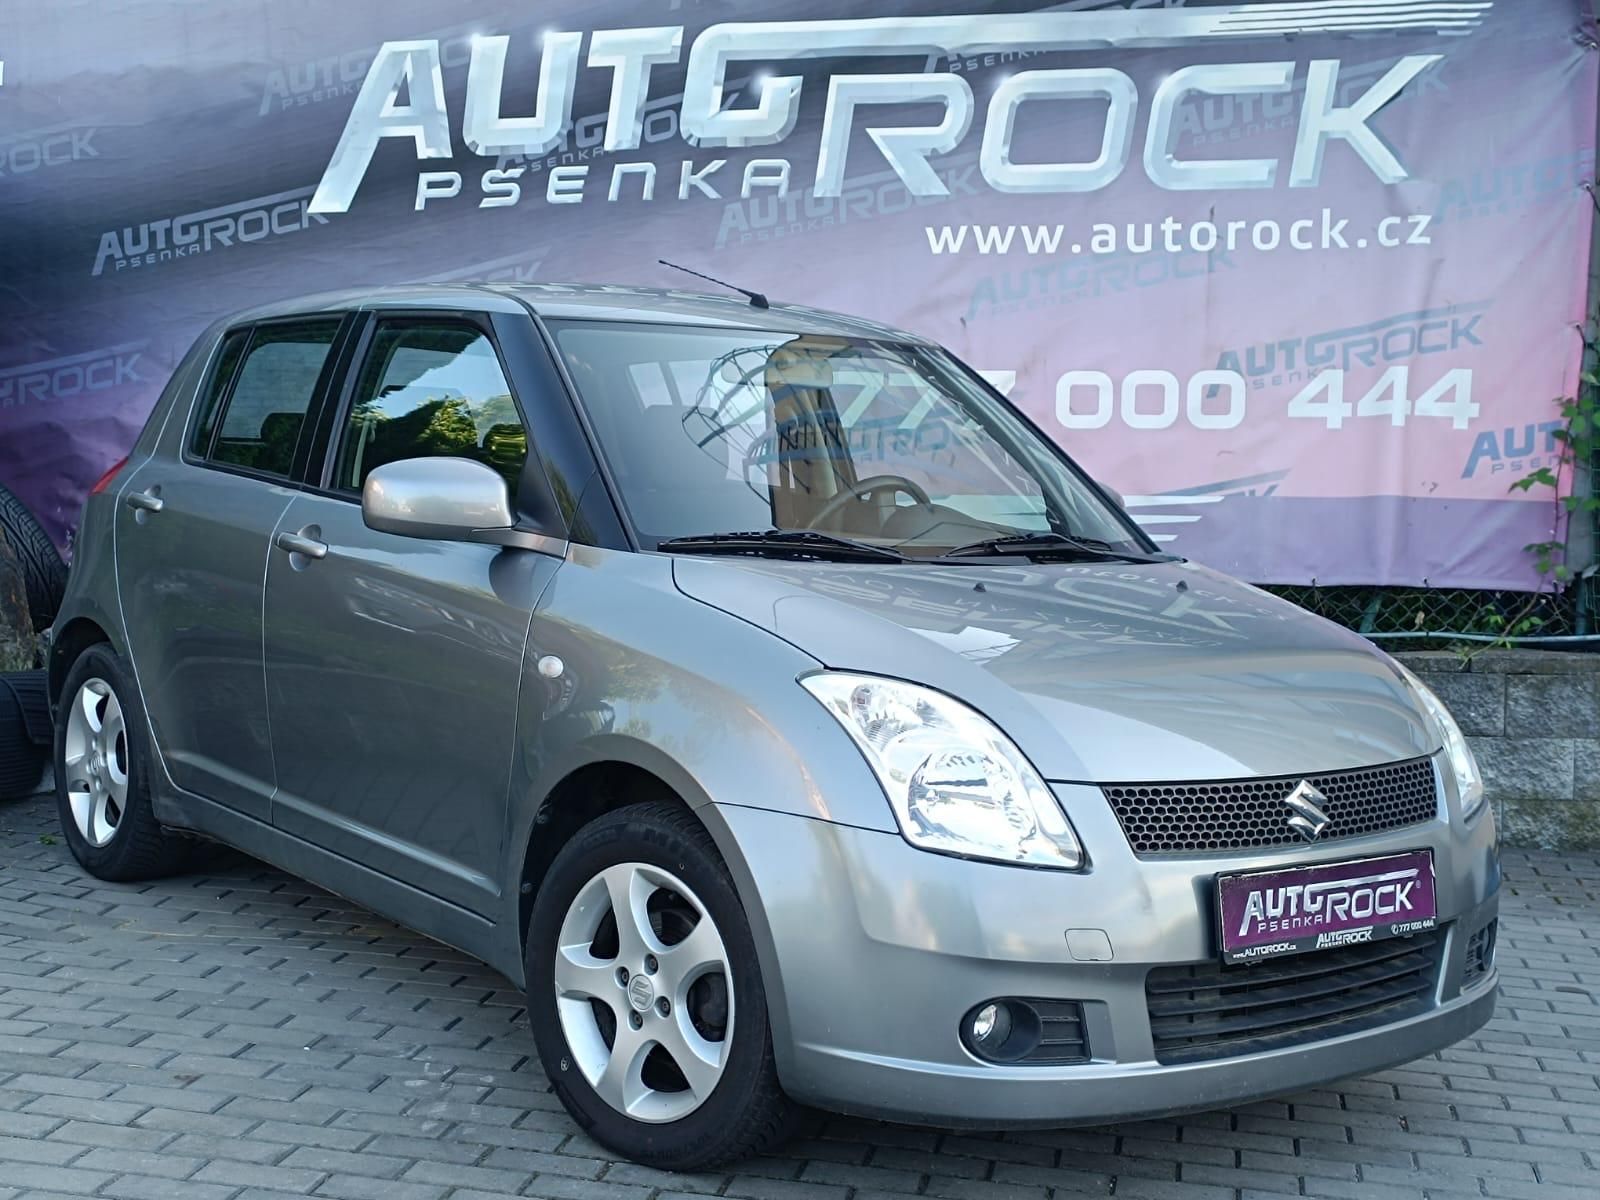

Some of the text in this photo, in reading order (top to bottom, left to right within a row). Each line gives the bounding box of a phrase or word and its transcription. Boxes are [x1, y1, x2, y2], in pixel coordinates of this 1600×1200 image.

[308, 20, 1446, 213] AUTOROCK
[925, 208, 1432, 255] www.autorock.cz
[115, 244, 201, 272] PSENKA
[1055, 369, 1246, 429] 000
[1287, 365, 1479, 430] 444
[1257, 914, 1324, 935] PSENKA
